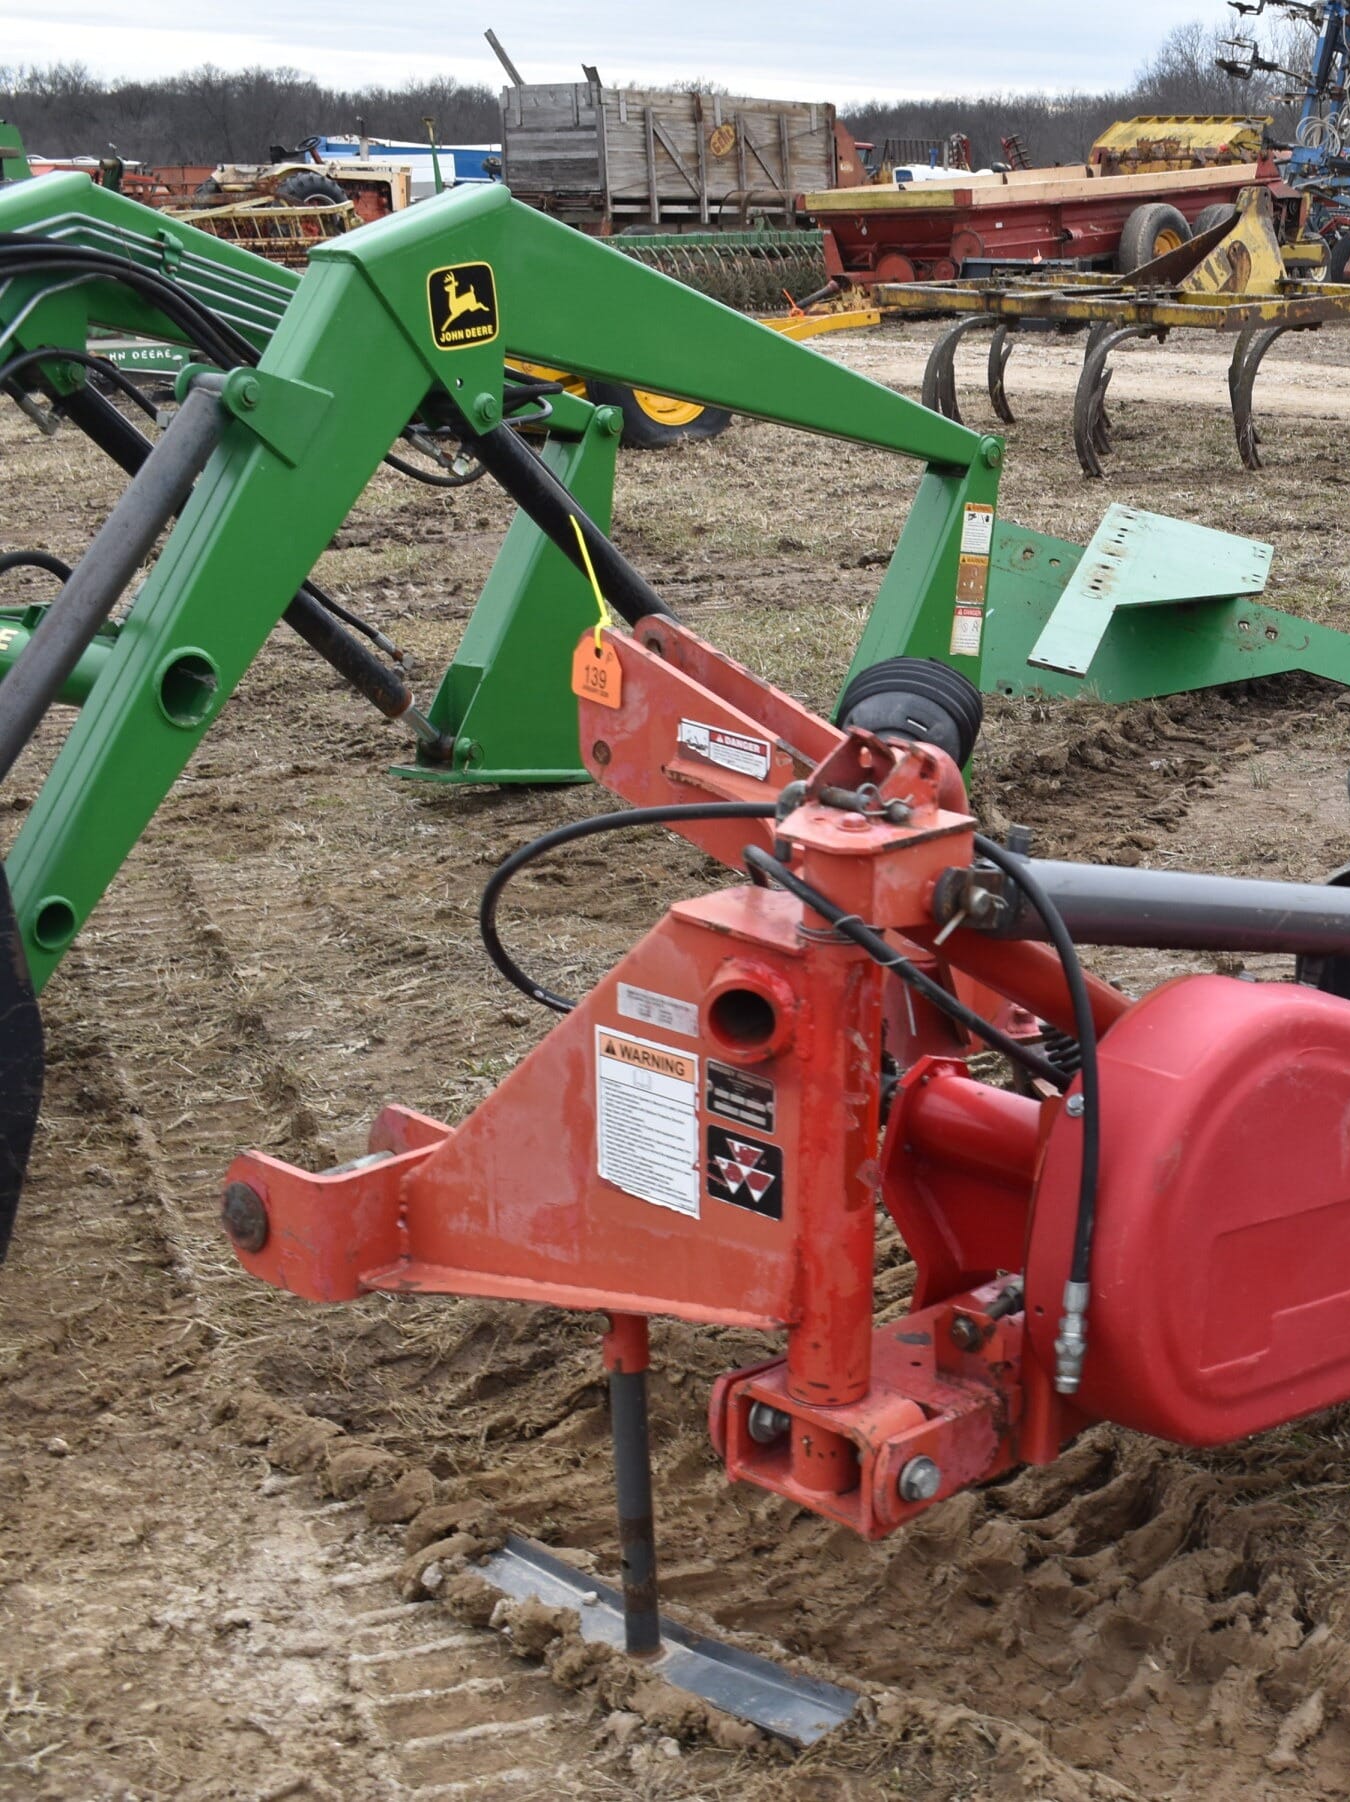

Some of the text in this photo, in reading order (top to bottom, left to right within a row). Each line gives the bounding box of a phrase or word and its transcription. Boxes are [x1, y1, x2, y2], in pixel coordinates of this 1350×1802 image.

[440, 324, 494, 343] JOHN DEERE
[108, 348, 172, 361] HN DEERE
[585, 664, 607, 690] 139
[724, 735, 761, 754] DANGER
[619, 1043, 685, 1077] WARNING
